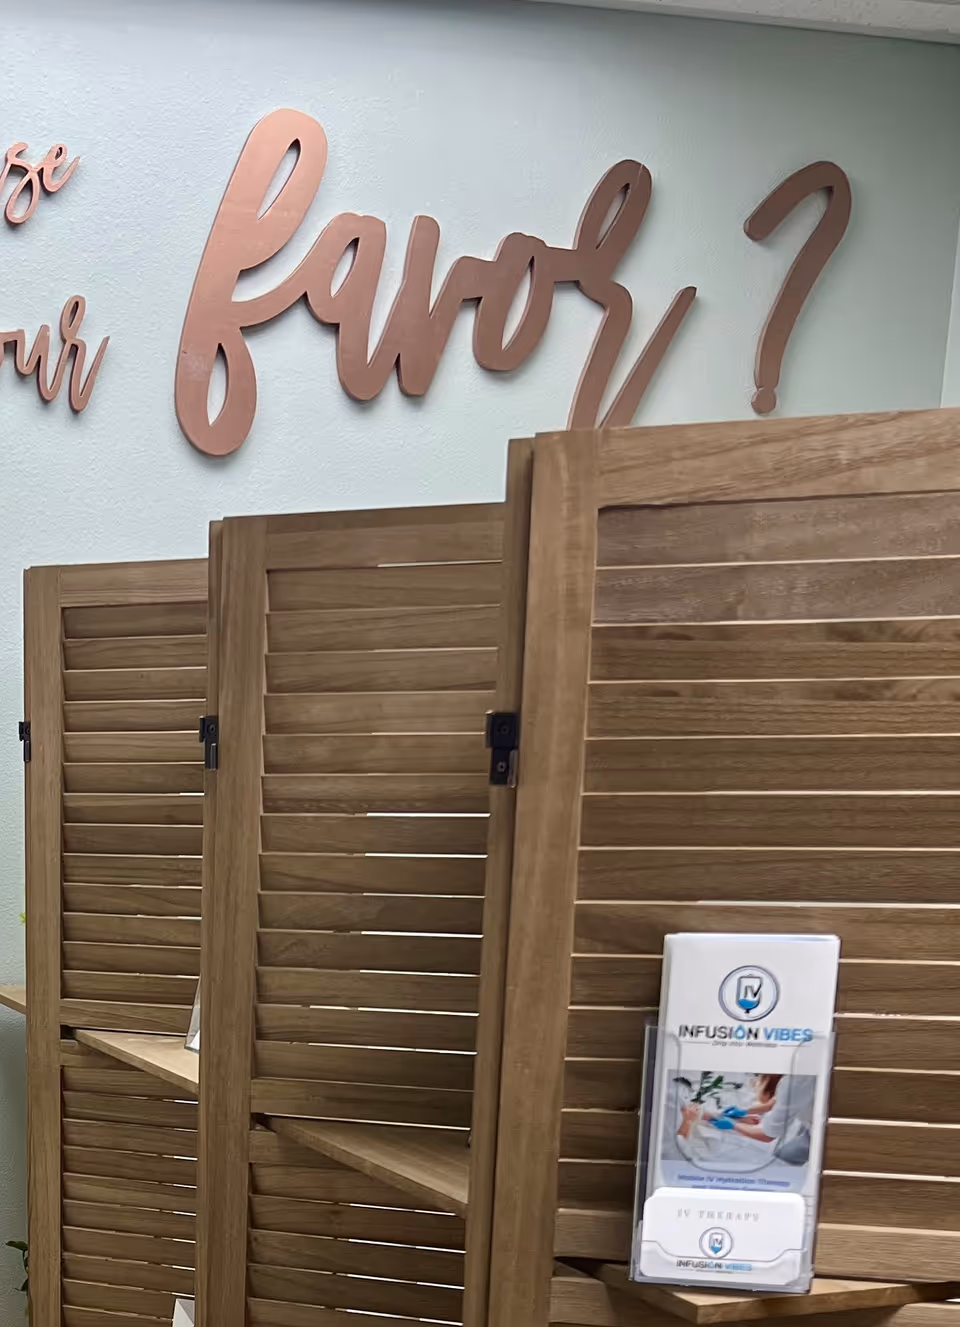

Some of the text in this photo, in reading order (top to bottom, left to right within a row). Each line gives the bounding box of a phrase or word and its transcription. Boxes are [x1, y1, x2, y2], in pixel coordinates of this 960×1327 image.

[174, 107, 697, 456] favor
[679, 1024, 813, 1042] INFUSION VIBES
[676, 1258, 722, 1270] INFUSION
